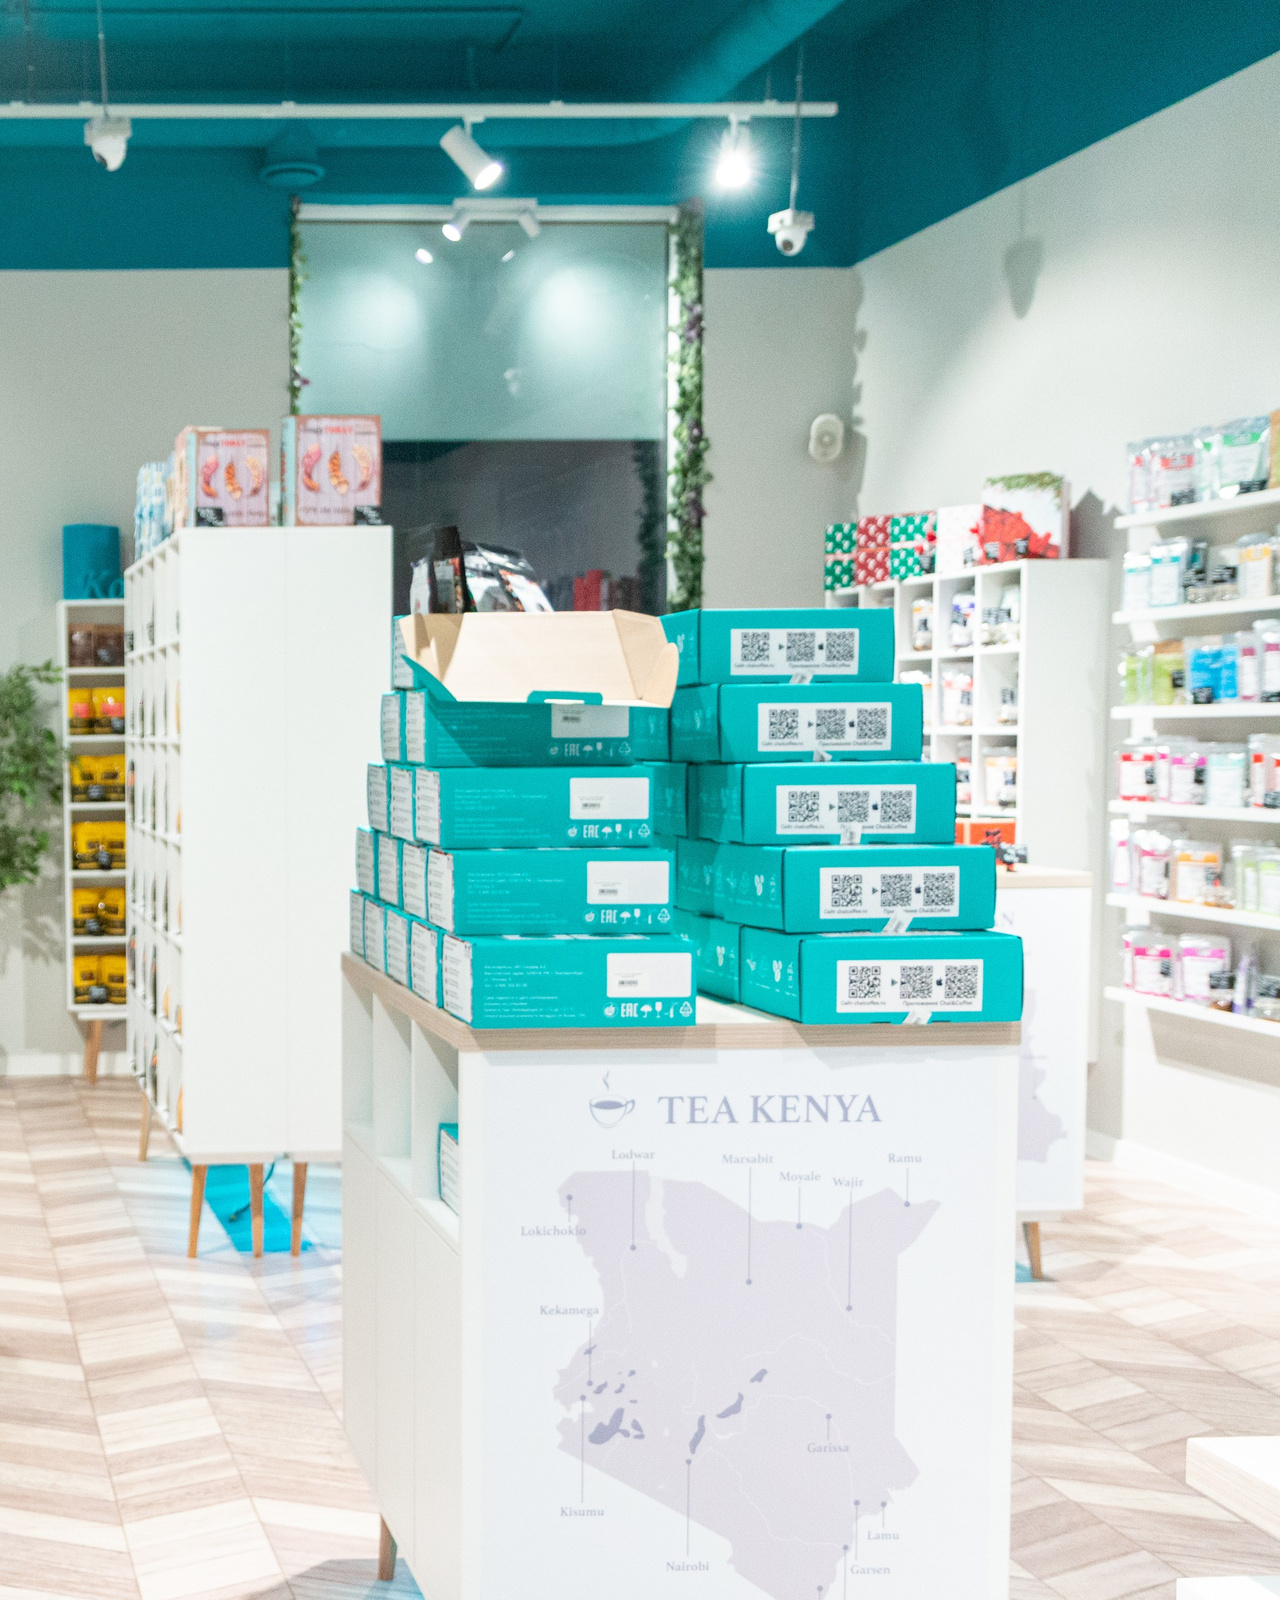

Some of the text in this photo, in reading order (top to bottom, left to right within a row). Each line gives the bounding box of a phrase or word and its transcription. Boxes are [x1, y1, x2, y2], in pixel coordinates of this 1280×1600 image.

[657, 1094, 883, 1124] TEA KENYA
[611, 1148, 655, 1160] Lodwar
[721, 1154, 773, 1164] Marsabit
[888, 1153, 922, 1163] Ramu
[779, 1171, 821, 1183] Moyale
[832, 1177, 864, 1189] Wajir
[521, 1225, 586, 1236] Lokichokio
[807, 1442, 849, 1453] Garissa
[560, 1507, 604, 1517] Kisumu
[867, 1530, 900, 1540] Lamu
[666, 1561, 709, 1572] Nairobi
[850, 1564, 890, 1575] Garsen
